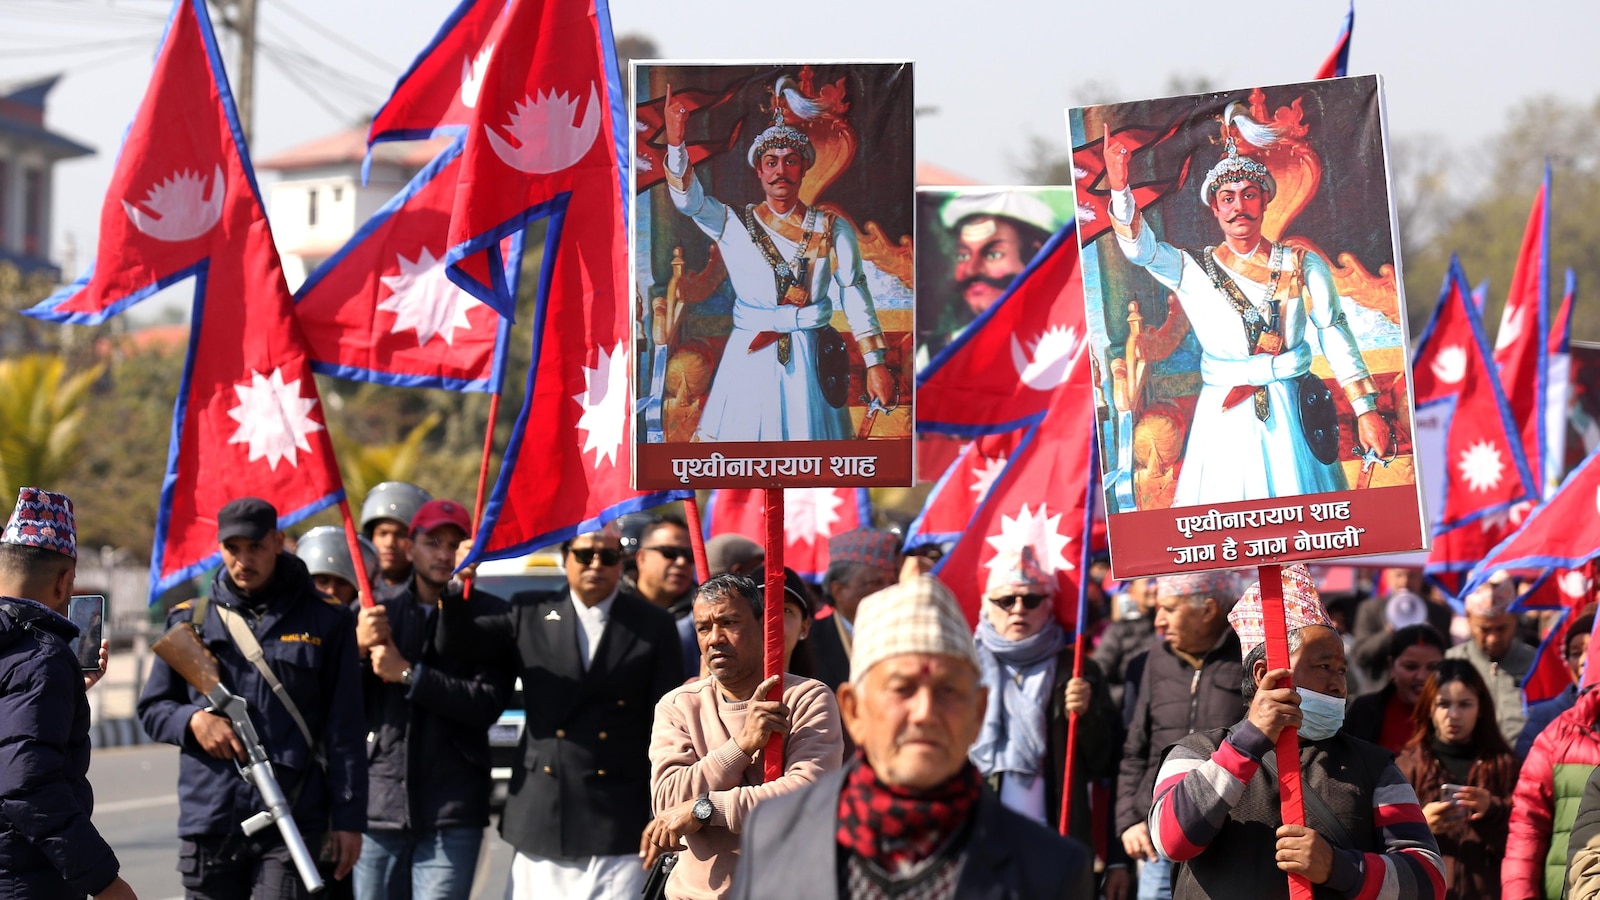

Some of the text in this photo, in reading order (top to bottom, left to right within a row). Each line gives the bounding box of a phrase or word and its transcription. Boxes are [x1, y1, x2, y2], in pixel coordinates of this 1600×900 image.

[672, 452, 878, 483] पृथ्वीनारायण शाह
[1175, 500, 1351, 538] पृथ्वीनारायण शाह
[1222, 537, 1238, 560] है
[1243, 536, 1287, 558] जाग
